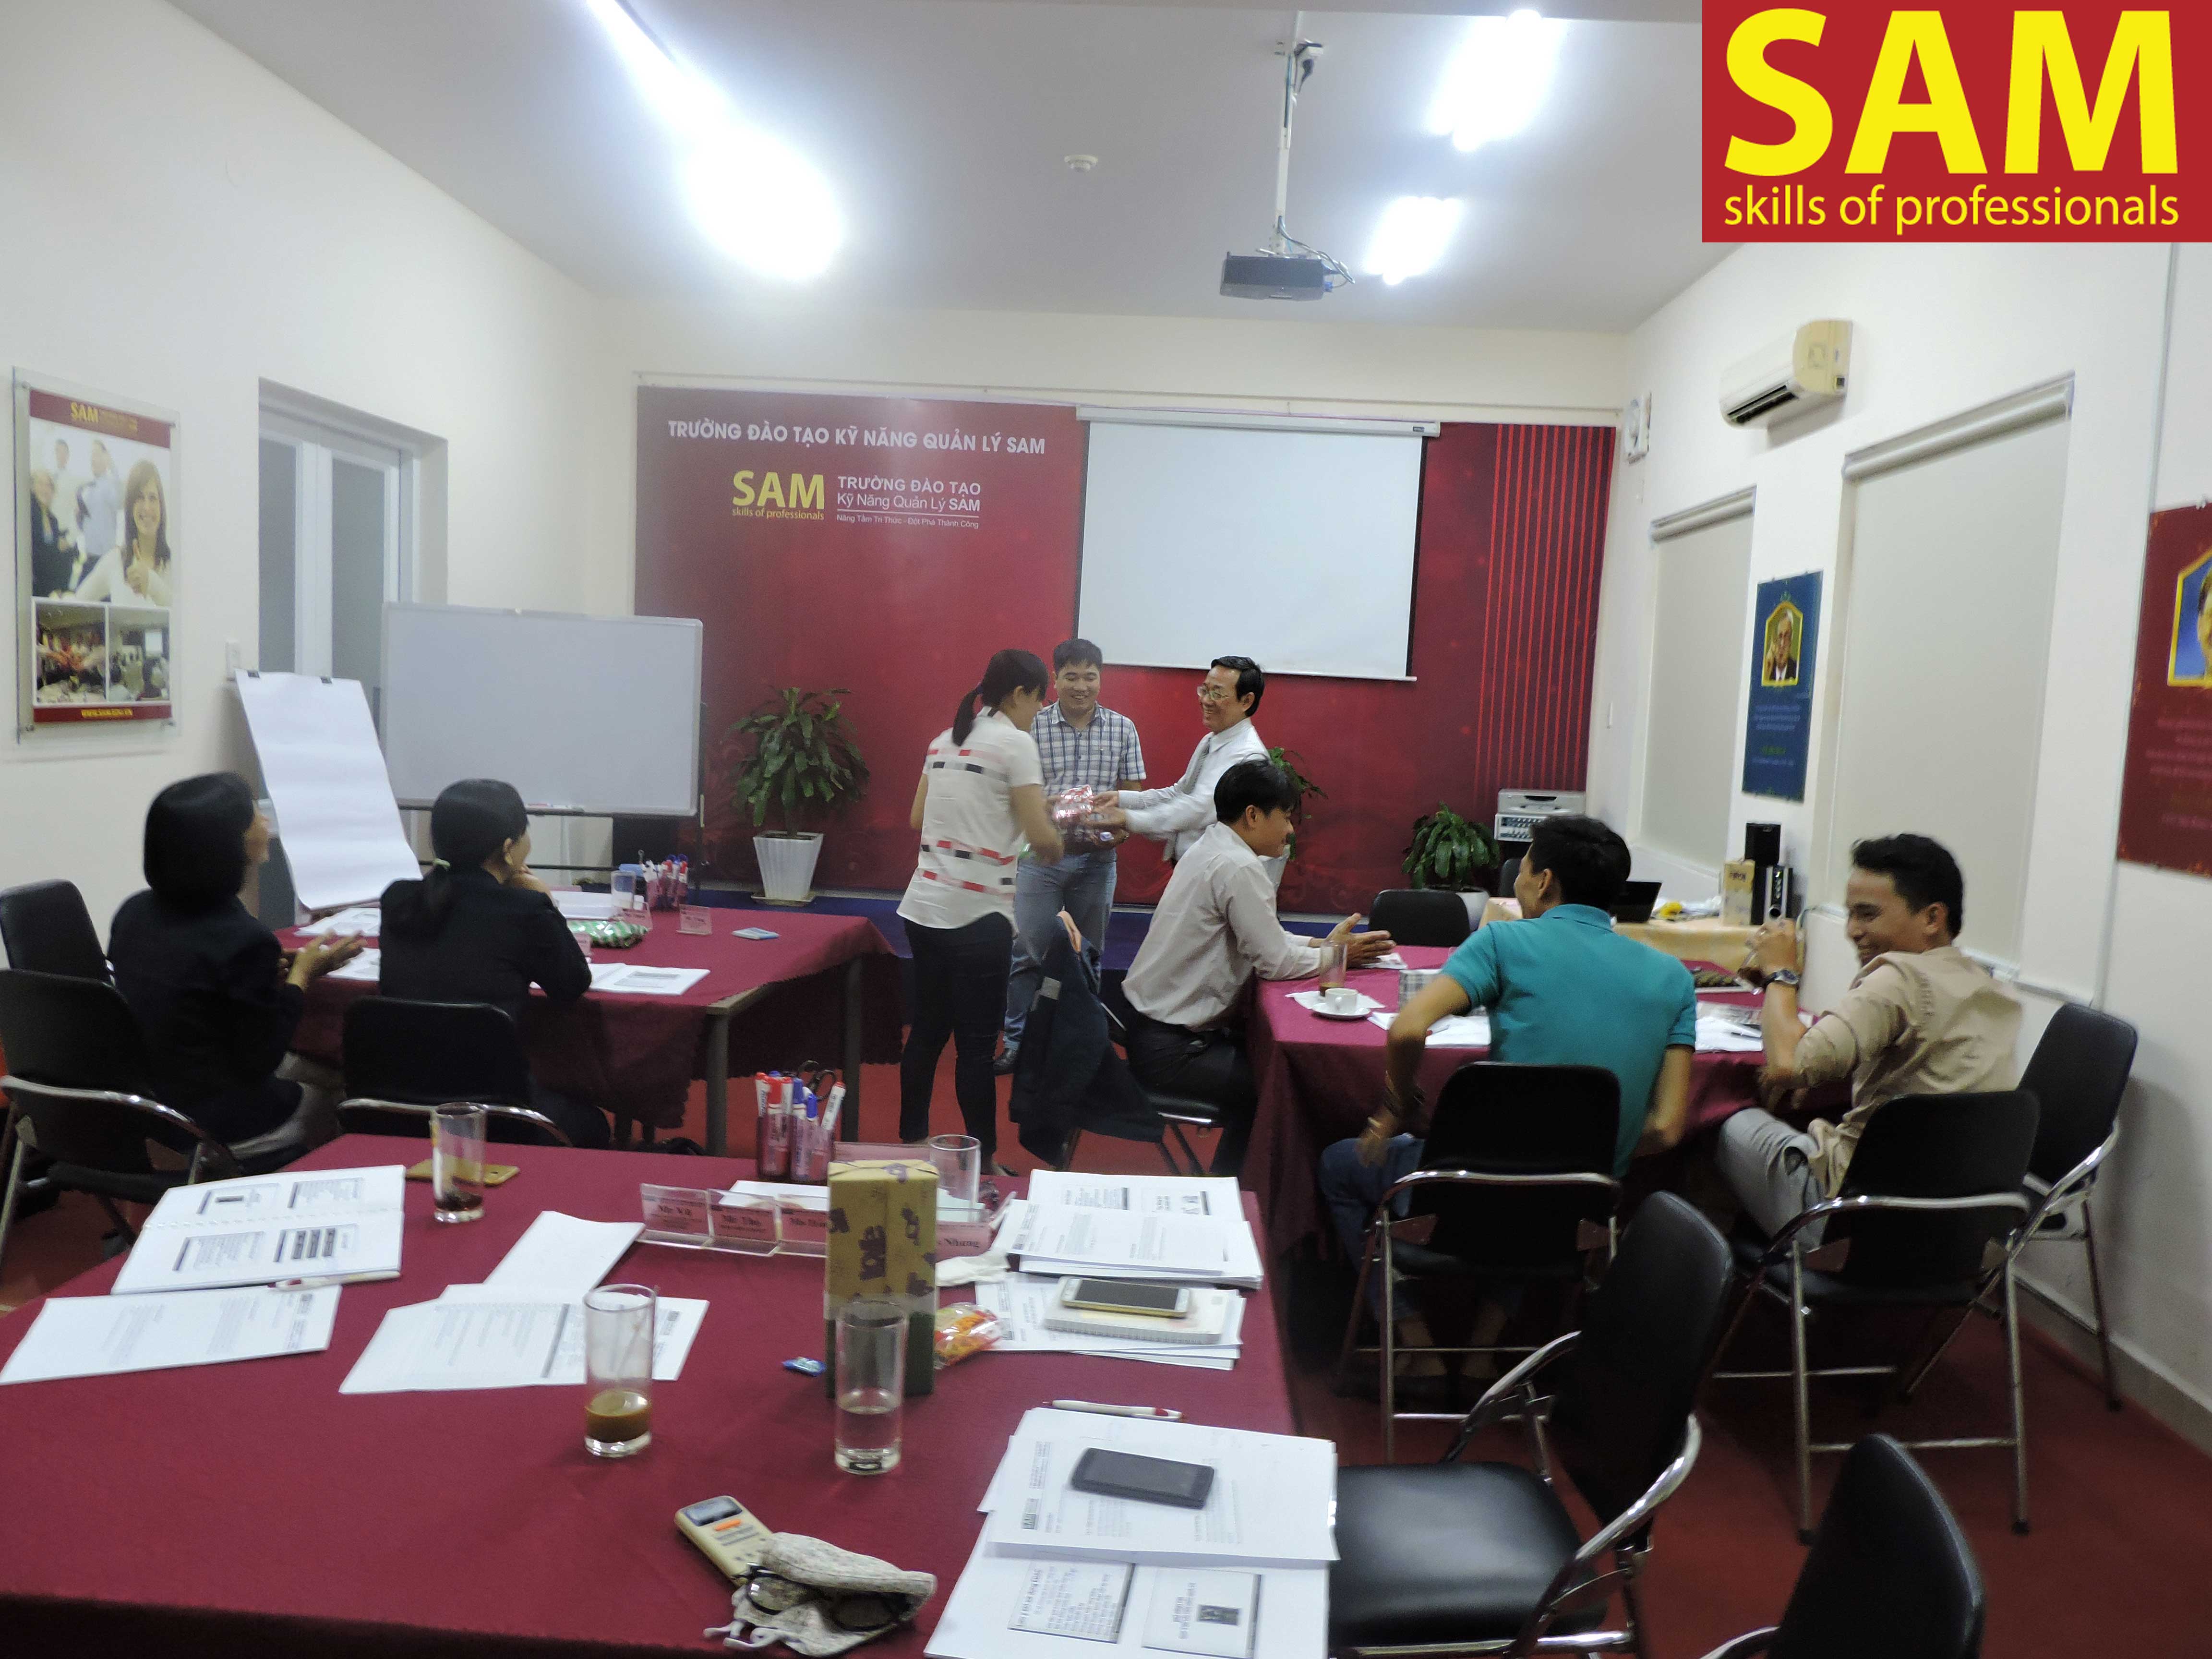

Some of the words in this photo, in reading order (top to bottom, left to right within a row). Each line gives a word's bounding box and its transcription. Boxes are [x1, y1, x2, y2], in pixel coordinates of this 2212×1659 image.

[71, 402, 98, 423] SAM
[668, 418, 742, 440] TRƯỜNG
[747, 421, 788, 442] ĐÀO
[793, 426, 830, 448] TẠO
[835, 425, 859, 445] KỸ
[864, 426, 918, 448] NĂNG
[923, 428, 976, 451] QUẢN
[982, 432, 1002, 452] LÝ
[1007, 436, 1045, 454] SAM
[733, 469, 825, 509] SAM
[838, 475, 906, 492] TRƯỜNG
[911, 477, 944, 493] ĐÀO
[949, 481, 981, 497] TẠO
[732, 507, 753, 517] skills
[755, 507, 765, 517] of
[766, 509, 824, 520] professionals
[837, 493, 854, 508] Kỹ
[857, 493, 890, 510] Năng
[893, 495, 927, 509] Quản
[931, 496, 946, 513] Lý
[949, 498, 980, 512] SAM
